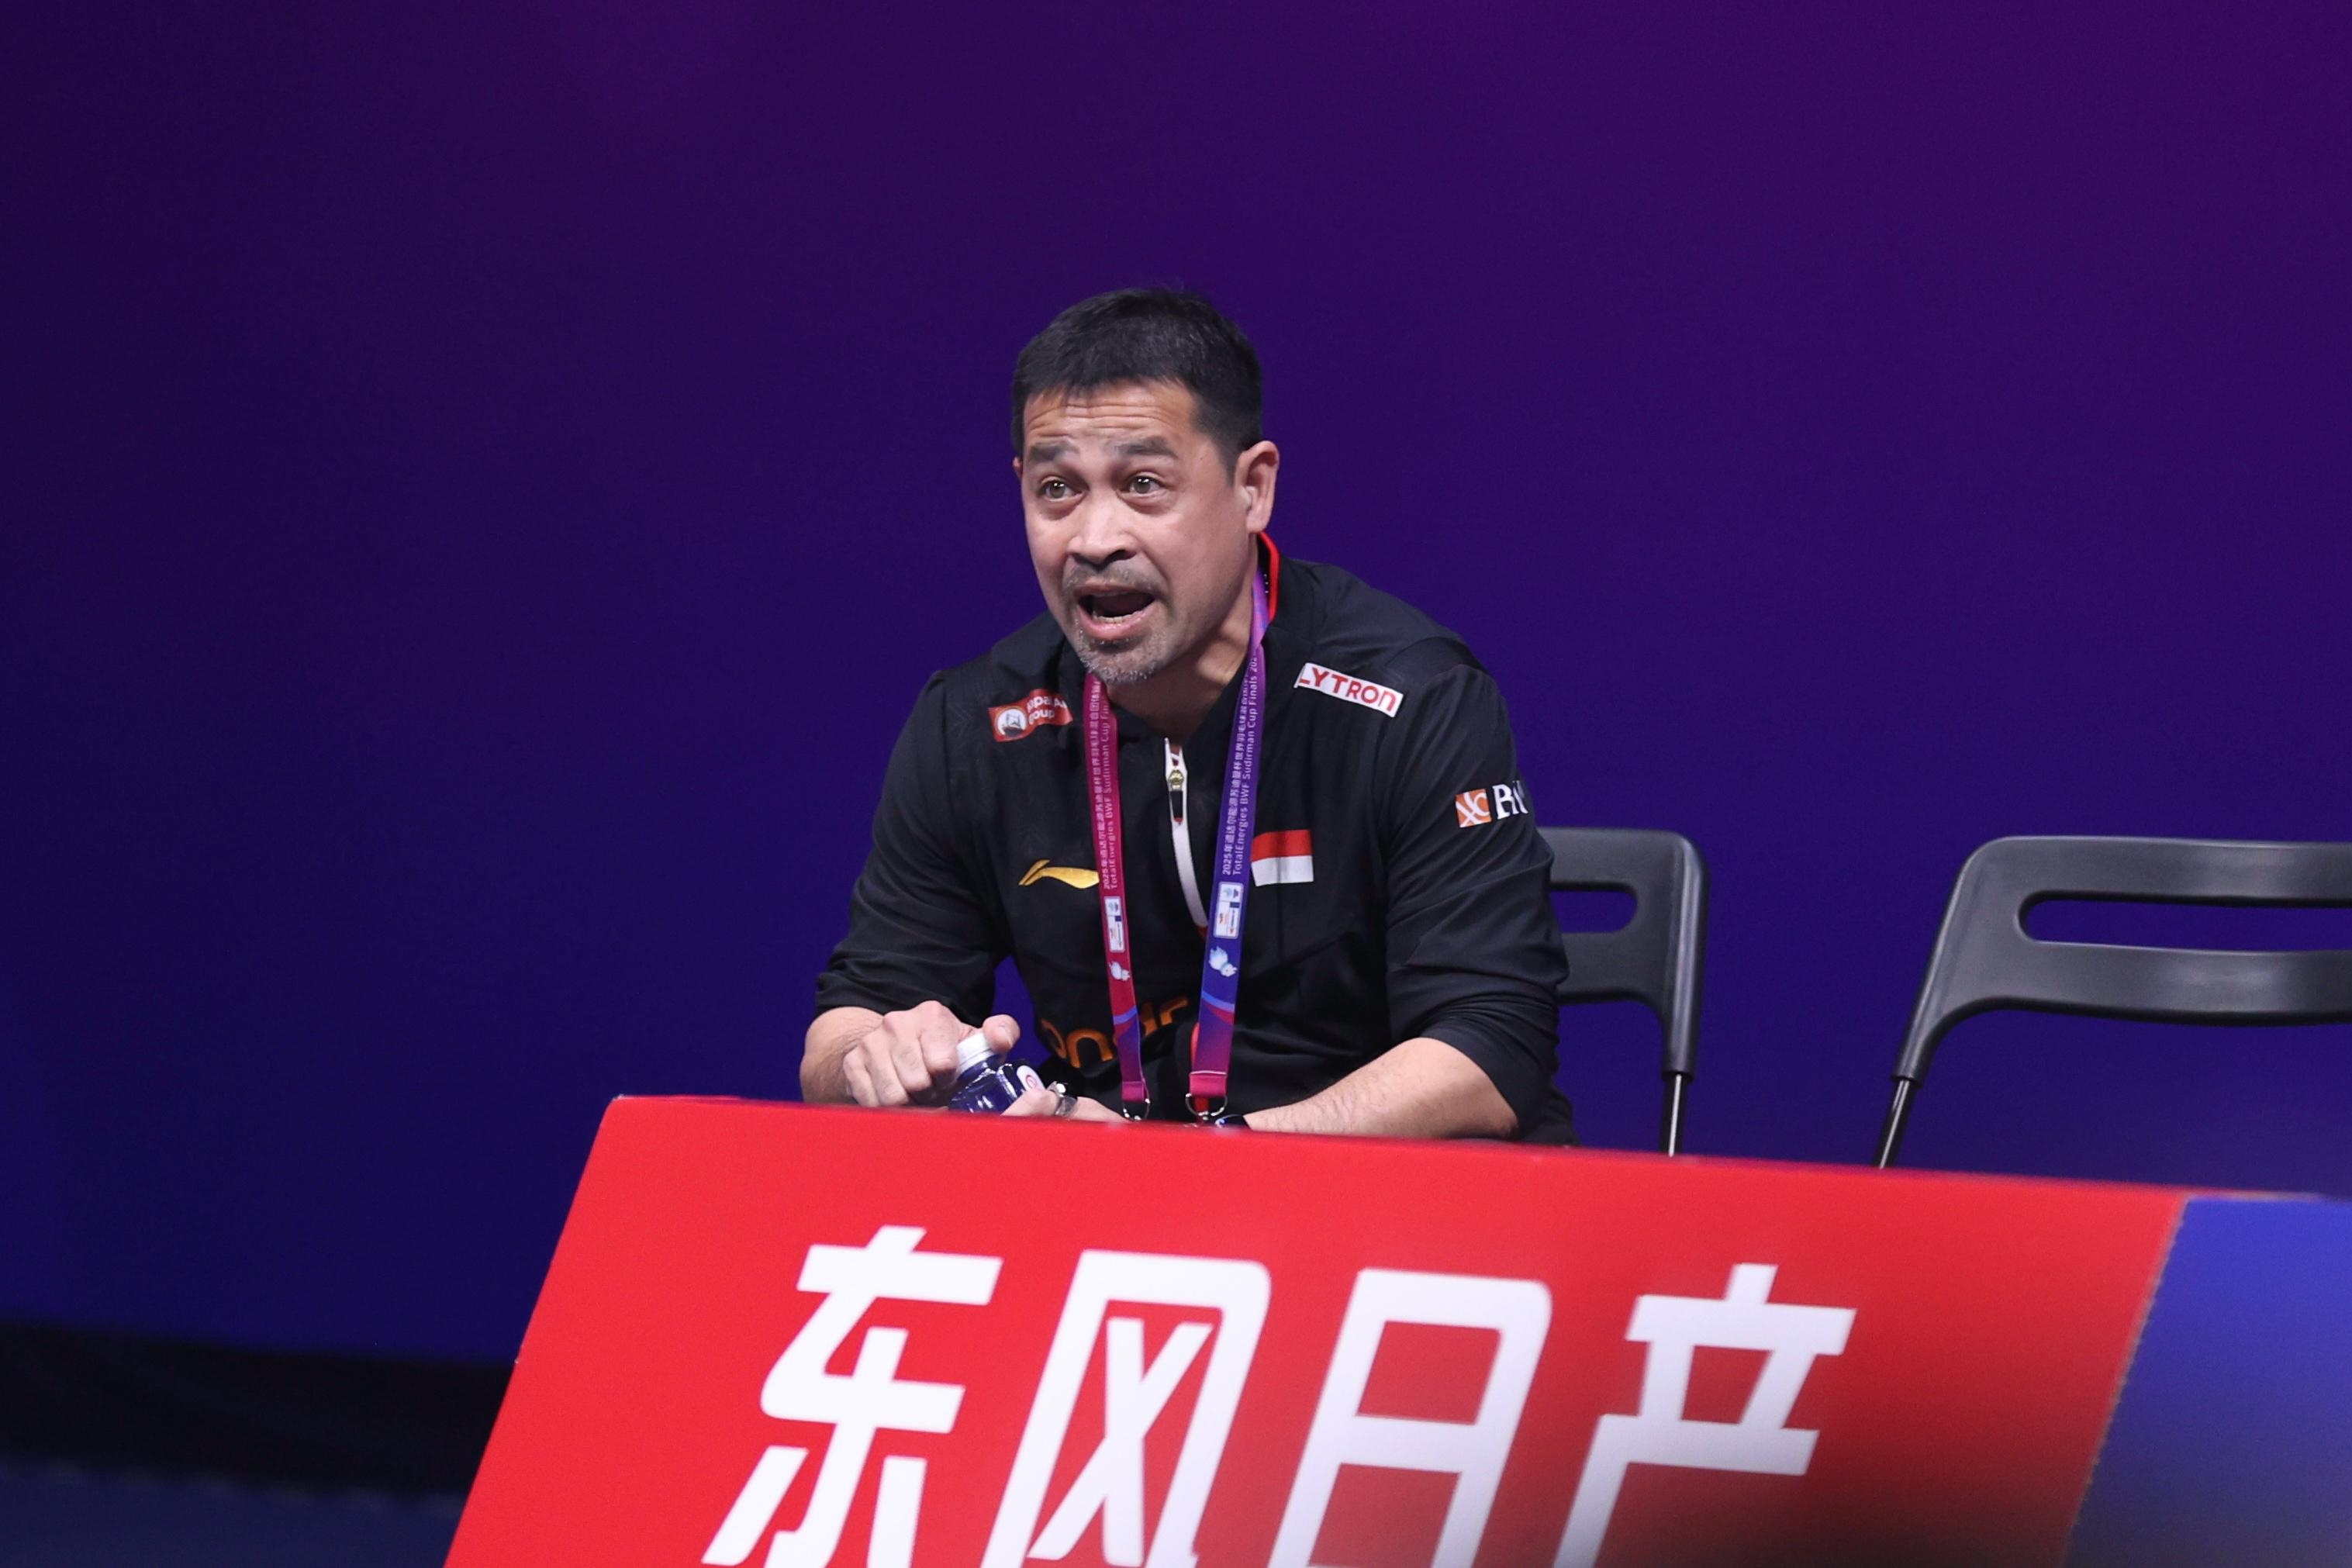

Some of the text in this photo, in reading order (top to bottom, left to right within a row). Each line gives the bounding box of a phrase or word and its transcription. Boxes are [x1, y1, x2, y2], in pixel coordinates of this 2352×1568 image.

[1249, 675, 1258, 706] Finals
[1100, 722, 1110, 743] Cup
[1246, 708, 1259, 729] Cup
[1101, 744, 1112, 794] Sudirman
[1242, 730, 1255, 780] Sudirman
[1103, 796, 1114, 819] BWF
[1239, 782, 1250, 805] BWF
[1107, 820, 1118, 890] TotalEnergies
[1232, 806, 1249, 876] TotalEnergies
[701, 1225, 1857, 1568] 东风日产
